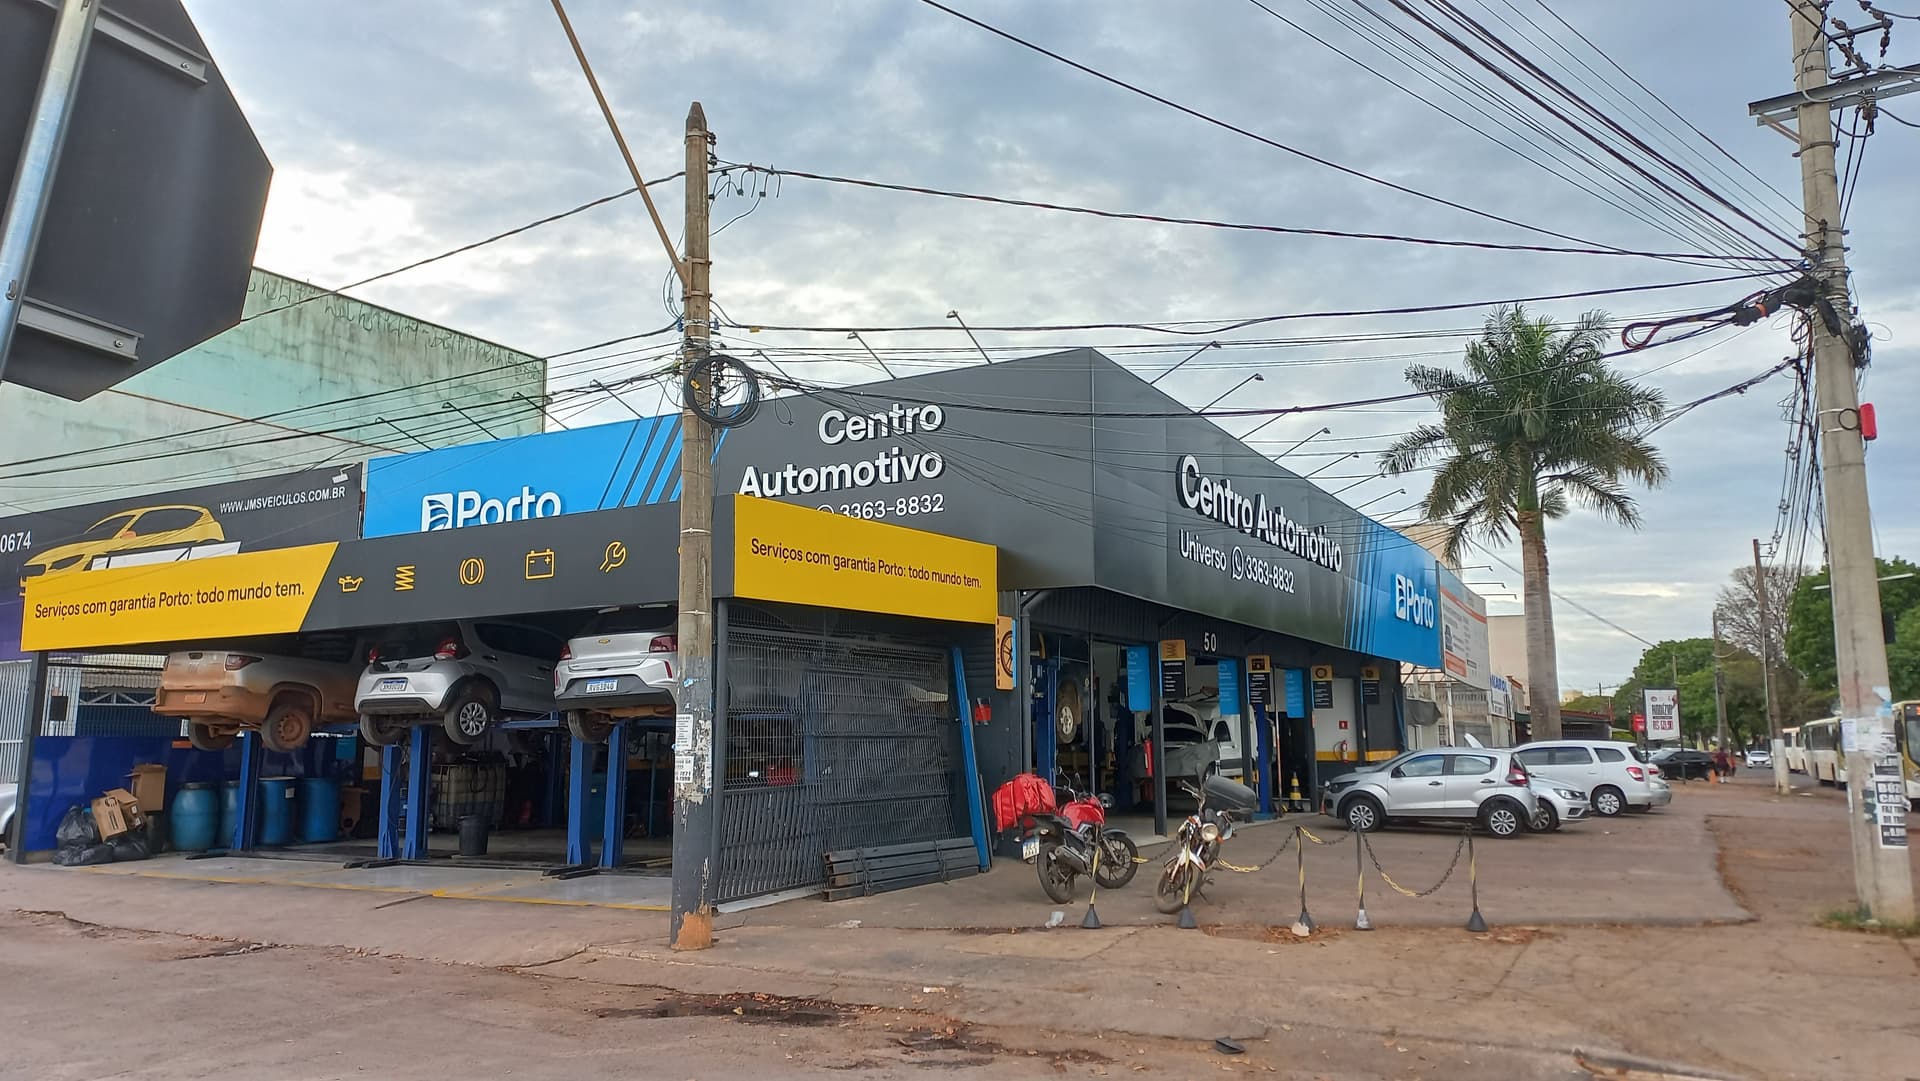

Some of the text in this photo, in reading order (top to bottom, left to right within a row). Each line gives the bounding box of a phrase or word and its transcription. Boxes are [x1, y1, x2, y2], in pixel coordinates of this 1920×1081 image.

[818, 403, 944, 445] Centro
[738, 447, 944, 498] Automotivo
[219, 486, 346, 514] WWW.JMSVEICULOS.COM.BR
[456, 486, 562, 529] Porto
[839, 493, 944, 520] 3363-8832
[1177, 454, 1342, 573] Centro Automotivo
[0, 531, 31, 553] 0674
[1179, 529, 1295, 594] Universo 3363-8832
[751, 538, 982, 589] Serviços com garantia Porto: todo mundo tem.
[35, 581, 305, 621] Serviços com garantia Porto: todo mundo tem.
[1406, 577, 1435, 629] Porto
[1203, 632, 1217, 652] 50
